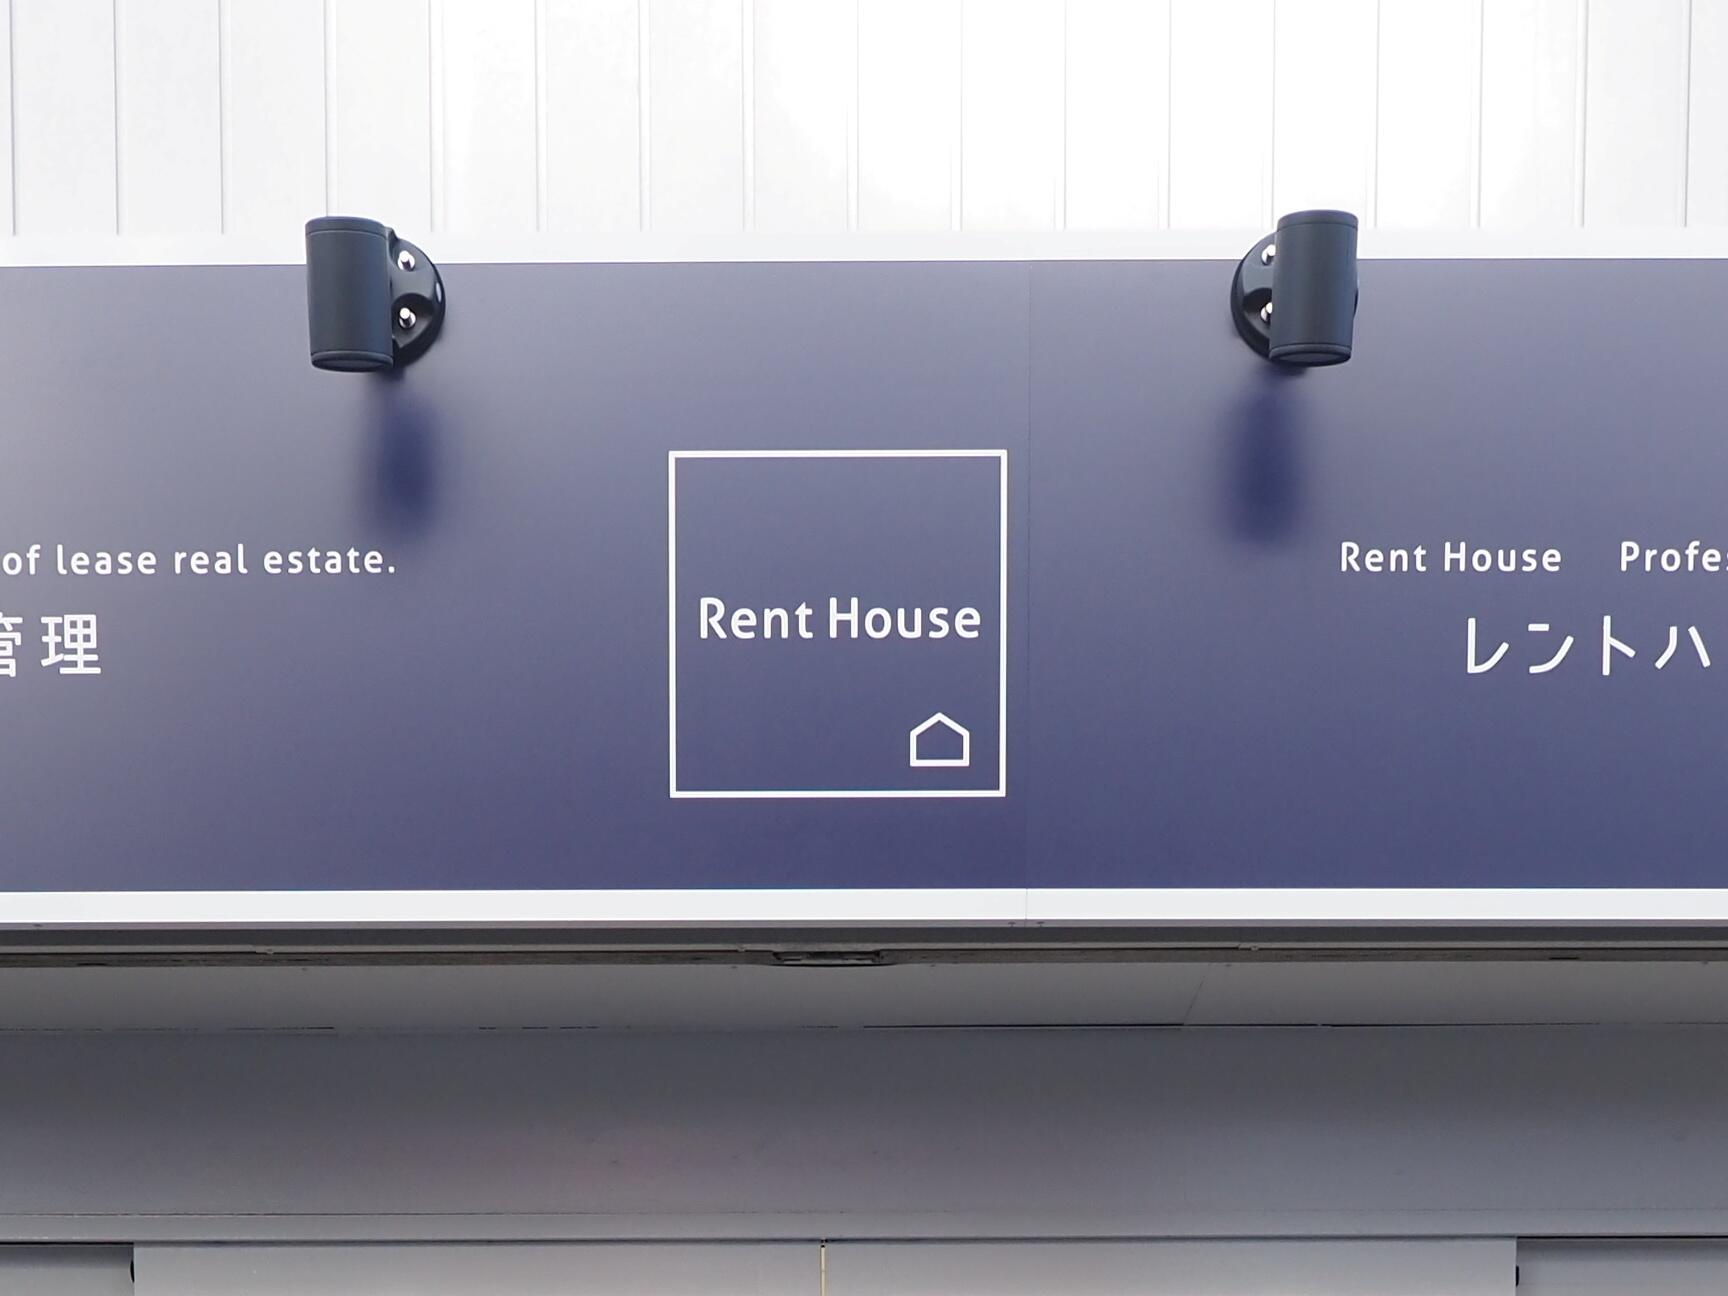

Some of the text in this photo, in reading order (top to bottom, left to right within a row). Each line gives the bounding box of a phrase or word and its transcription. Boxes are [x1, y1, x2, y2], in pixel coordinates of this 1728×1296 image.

[2, 544, 41, 576] of
[56, 544, 157, 575] lease
[174, 543, 248, 575] real
[263, 547, 395, 574] estate.
[1341, 541, 1427, 572] Rent
[1444, 541, 1562, 572] House
[700, 596, 981, 639] Rent House
